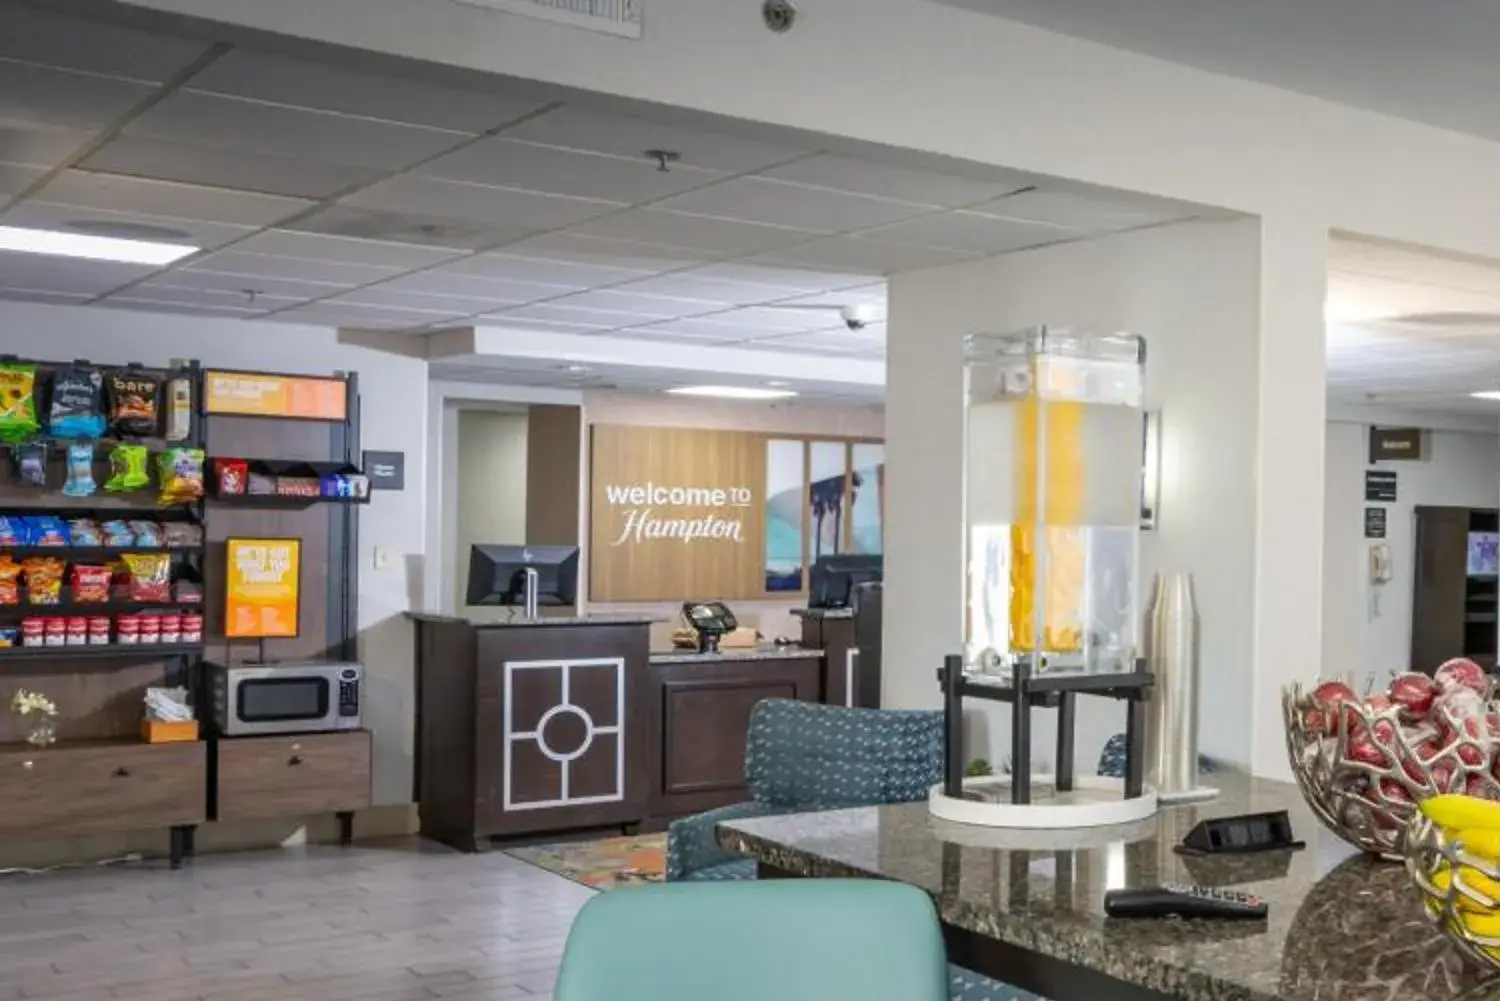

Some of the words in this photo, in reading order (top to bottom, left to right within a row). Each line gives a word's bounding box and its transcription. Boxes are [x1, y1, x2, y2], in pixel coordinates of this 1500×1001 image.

[113, 377, 155, 393] bare
[606, 480, 727, 507] welcome
[729, 487, 752, 504] TO
[608, 508, 746, 546] Hampton
